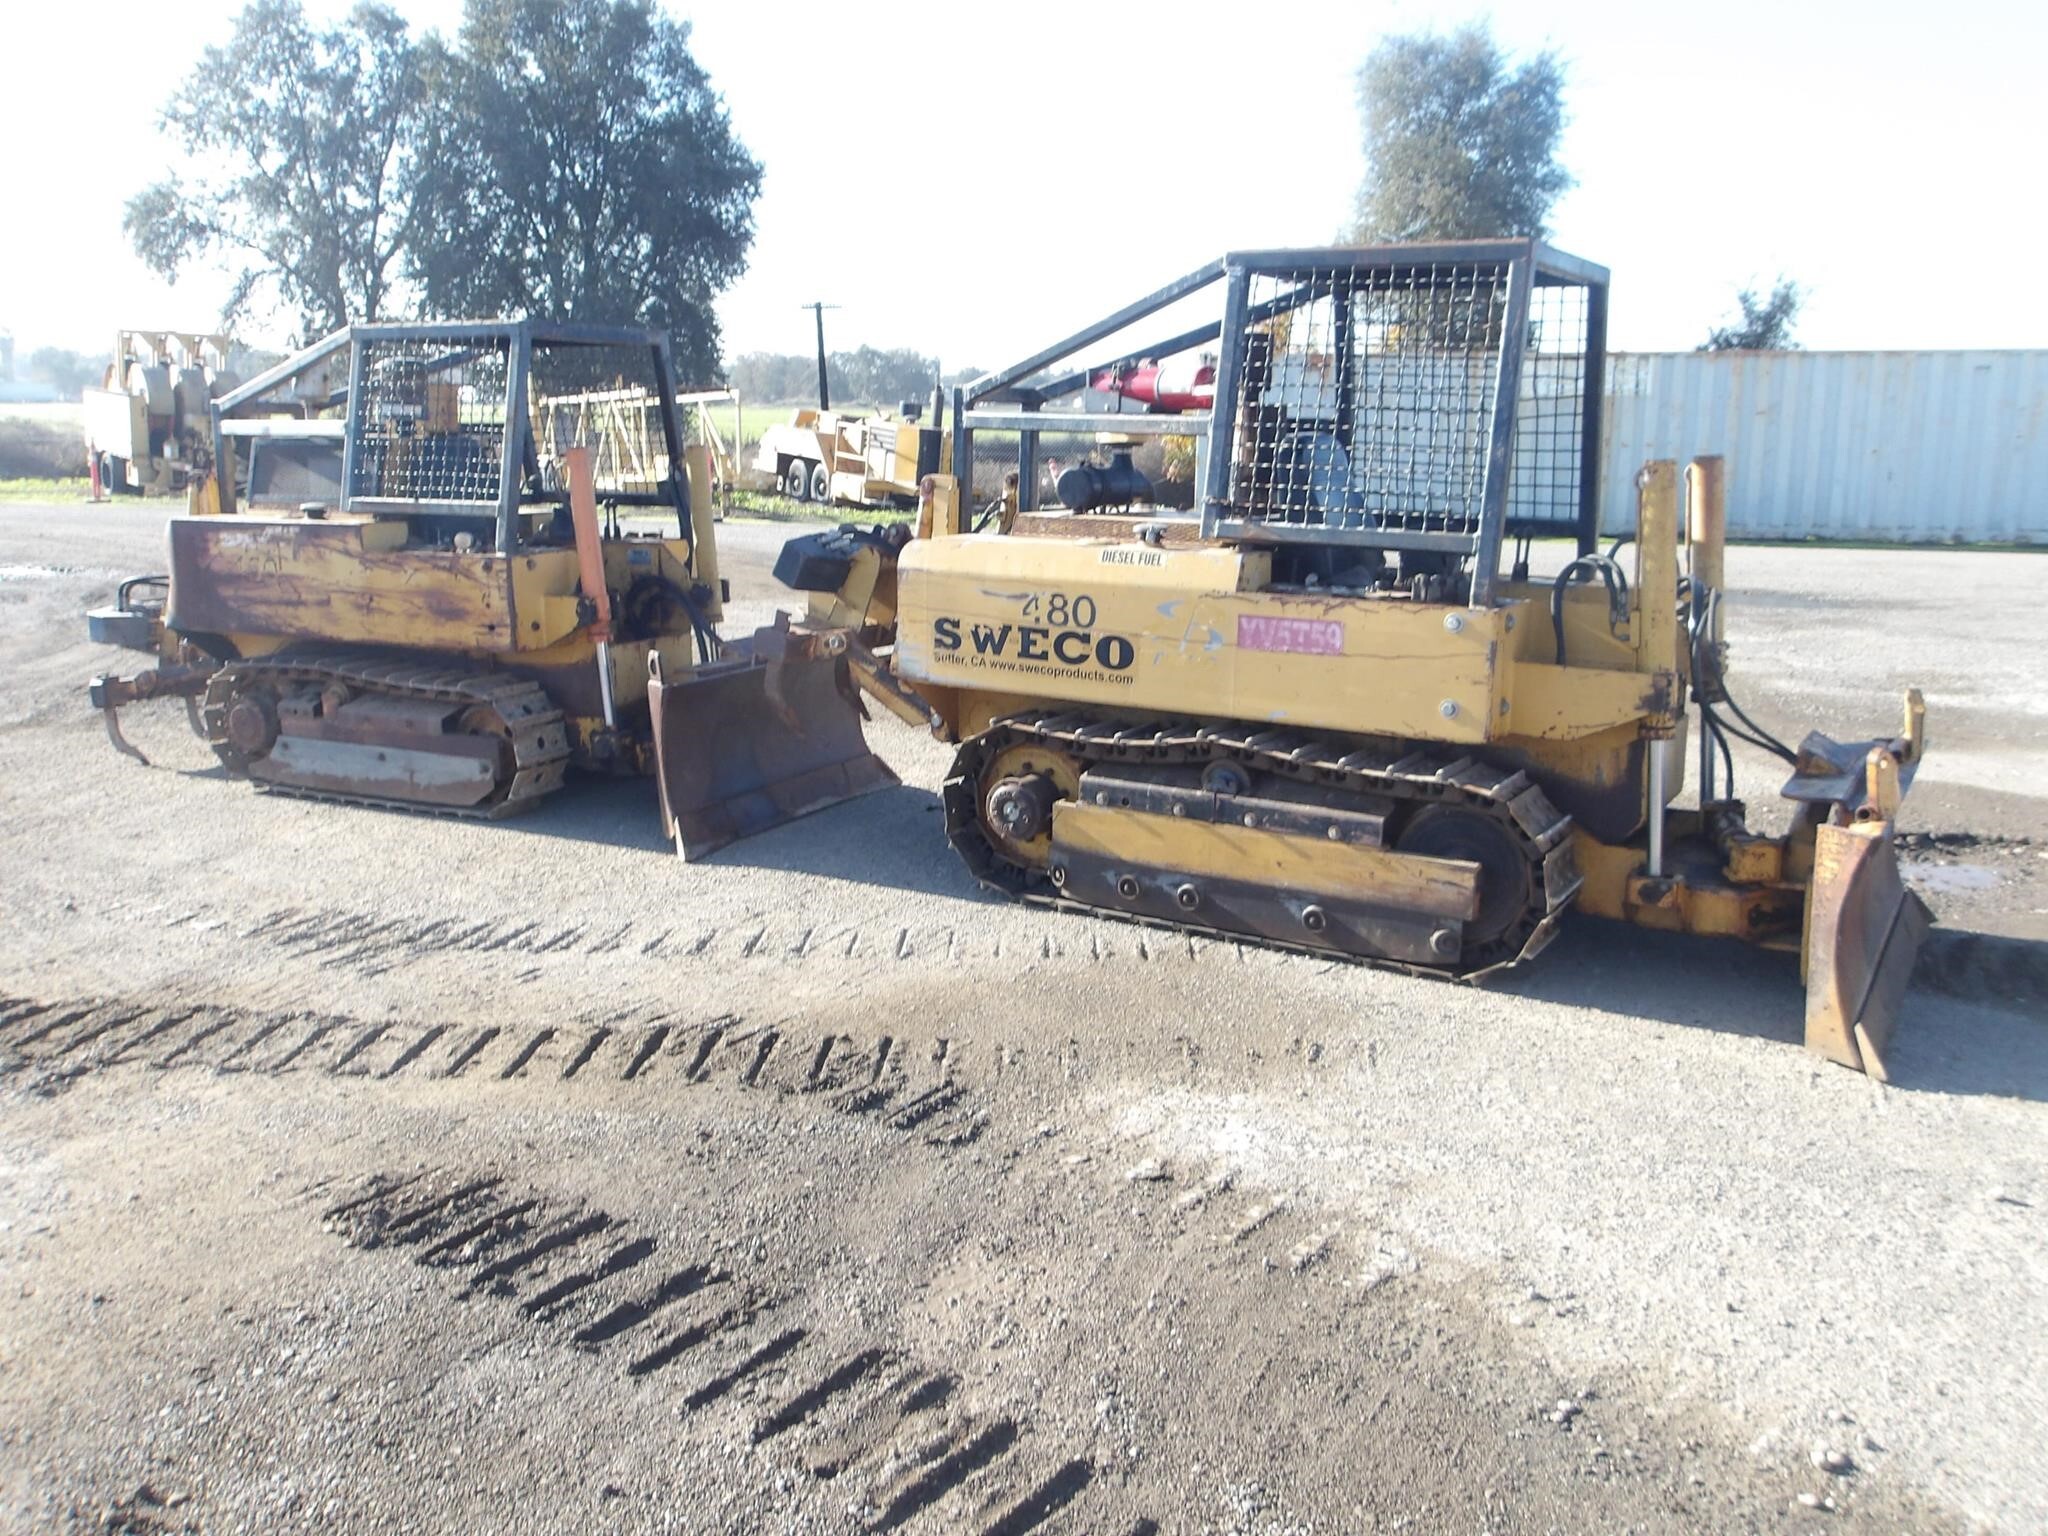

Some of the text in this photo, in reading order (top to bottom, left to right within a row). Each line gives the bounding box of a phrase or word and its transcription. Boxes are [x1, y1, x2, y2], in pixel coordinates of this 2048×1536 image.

[1101, 549, 1162, 566] DIESEL FUEL
[1022, 593, 1096, 628] 480
[934, 617, 1135, 670] SWECO
[970, 656, 987, 669] CA
[989, 660, 1134, 685] www.swecoproducts.com
